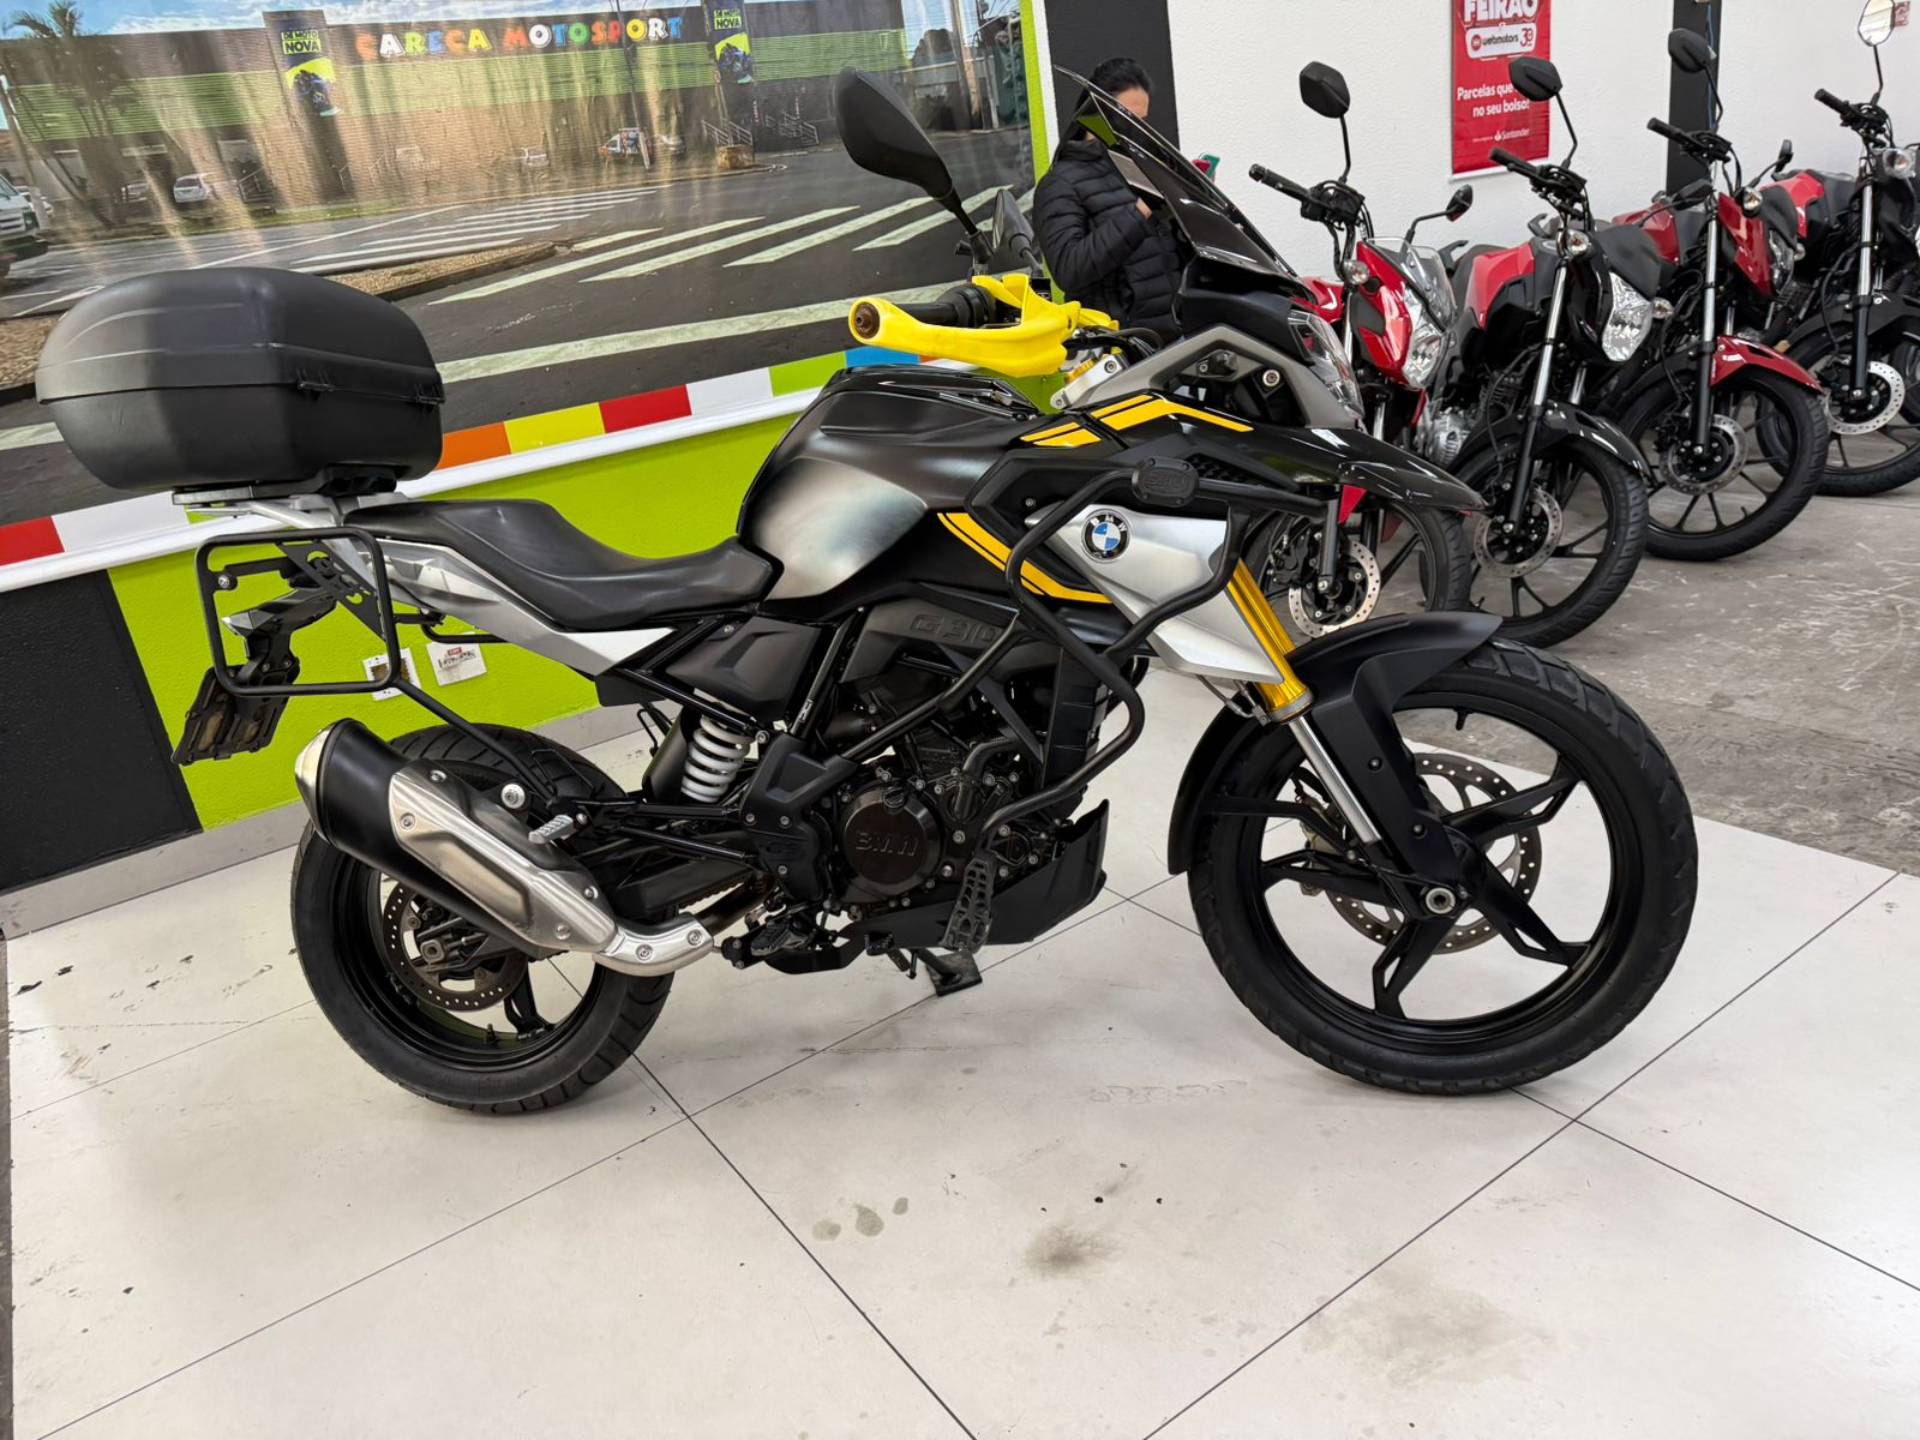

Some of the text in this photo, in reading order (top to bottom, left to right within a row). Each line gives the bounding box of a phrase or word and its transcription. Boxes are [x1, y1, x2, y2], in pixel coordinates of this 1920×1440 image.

[716, 17, 741, 28] NOVA
[355, 16, 684, 60] CARECA MOTOSPORT
[1482, 34, 1519, 46] webmotors
[285, 40, 320, 53] NOVA
[1457, 83, 1514, 100] Parcelas que
[1472, 106, 1485, 118] no
[1486, 104, 1502, 115] seu
[856, 831, 919, 857] BMW
